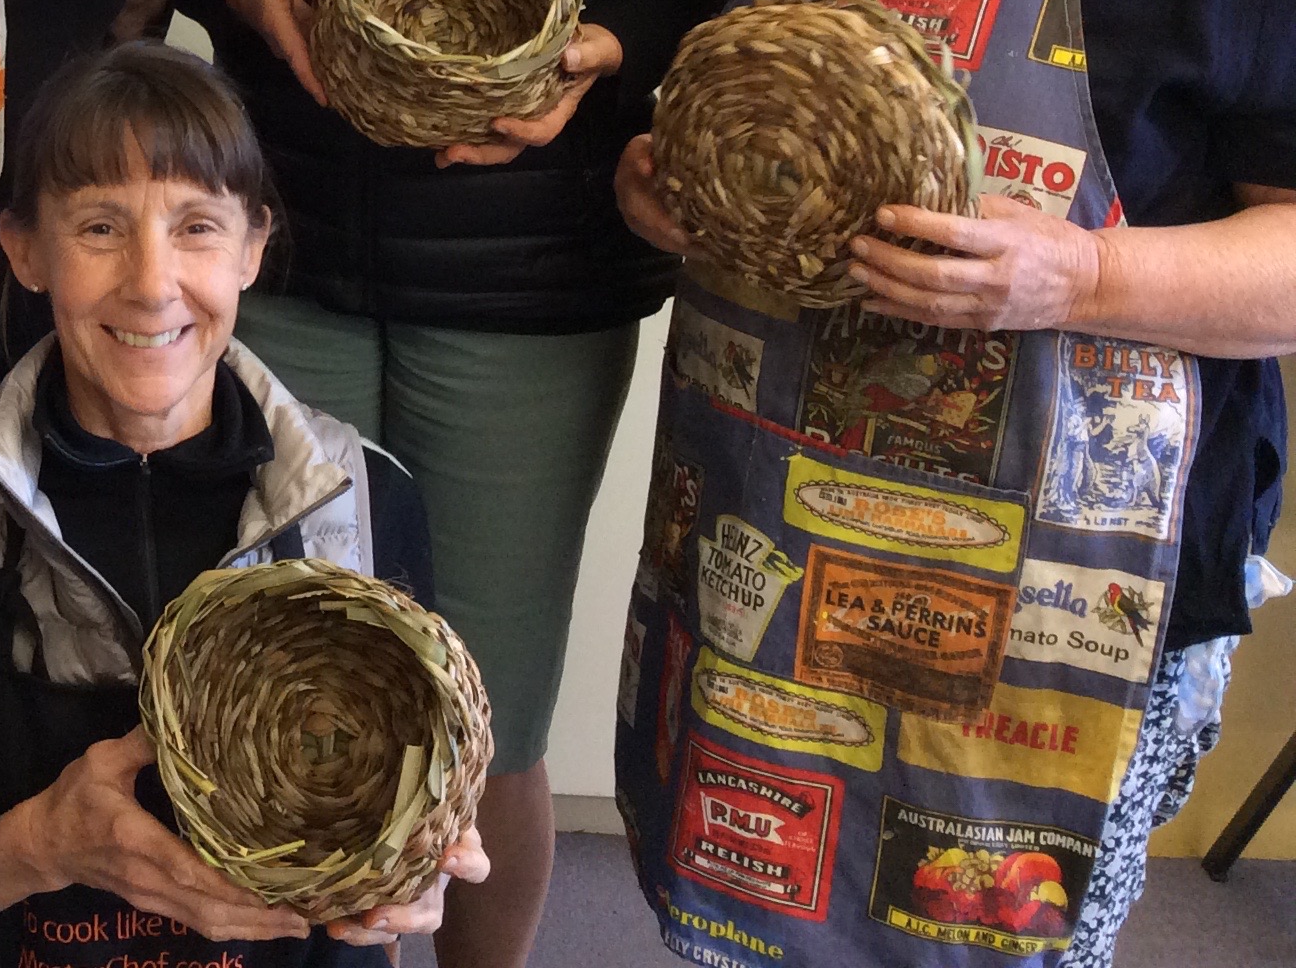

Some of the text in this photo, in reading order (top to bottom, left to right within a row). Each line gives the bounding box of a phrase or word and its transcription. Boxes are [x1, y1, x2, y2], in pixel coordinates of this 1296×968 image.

[1072, 342, 1177, 379] BILLY
[1107, 376, 1181, 403] TEA
[887, 435, 942, 455] FAMOUS
[708, 545, 767, 592] TOMATO
[700, 565, 766, 613] KETCHUP
[825, 588, 988, 639] LEA & PERRINS
[866, 615, 941, 648] SAUCE
[1066, 630, 1130, 663] Soup
[697, 771, 805, 813] LANCASHIRE
[897, 809, 1003, 842] AUSTRALASIAN
[1006, 826, 1036, 844] JAM
[700, 840, 784, 878] RELISH
[42, 913, 109, 945] cook
[115, 910, 164, 940] like
[936, 927, 971, 943] MELON
[973, 929, 995, 945] AND
[1000, 937, 1038, 953] GINGER
